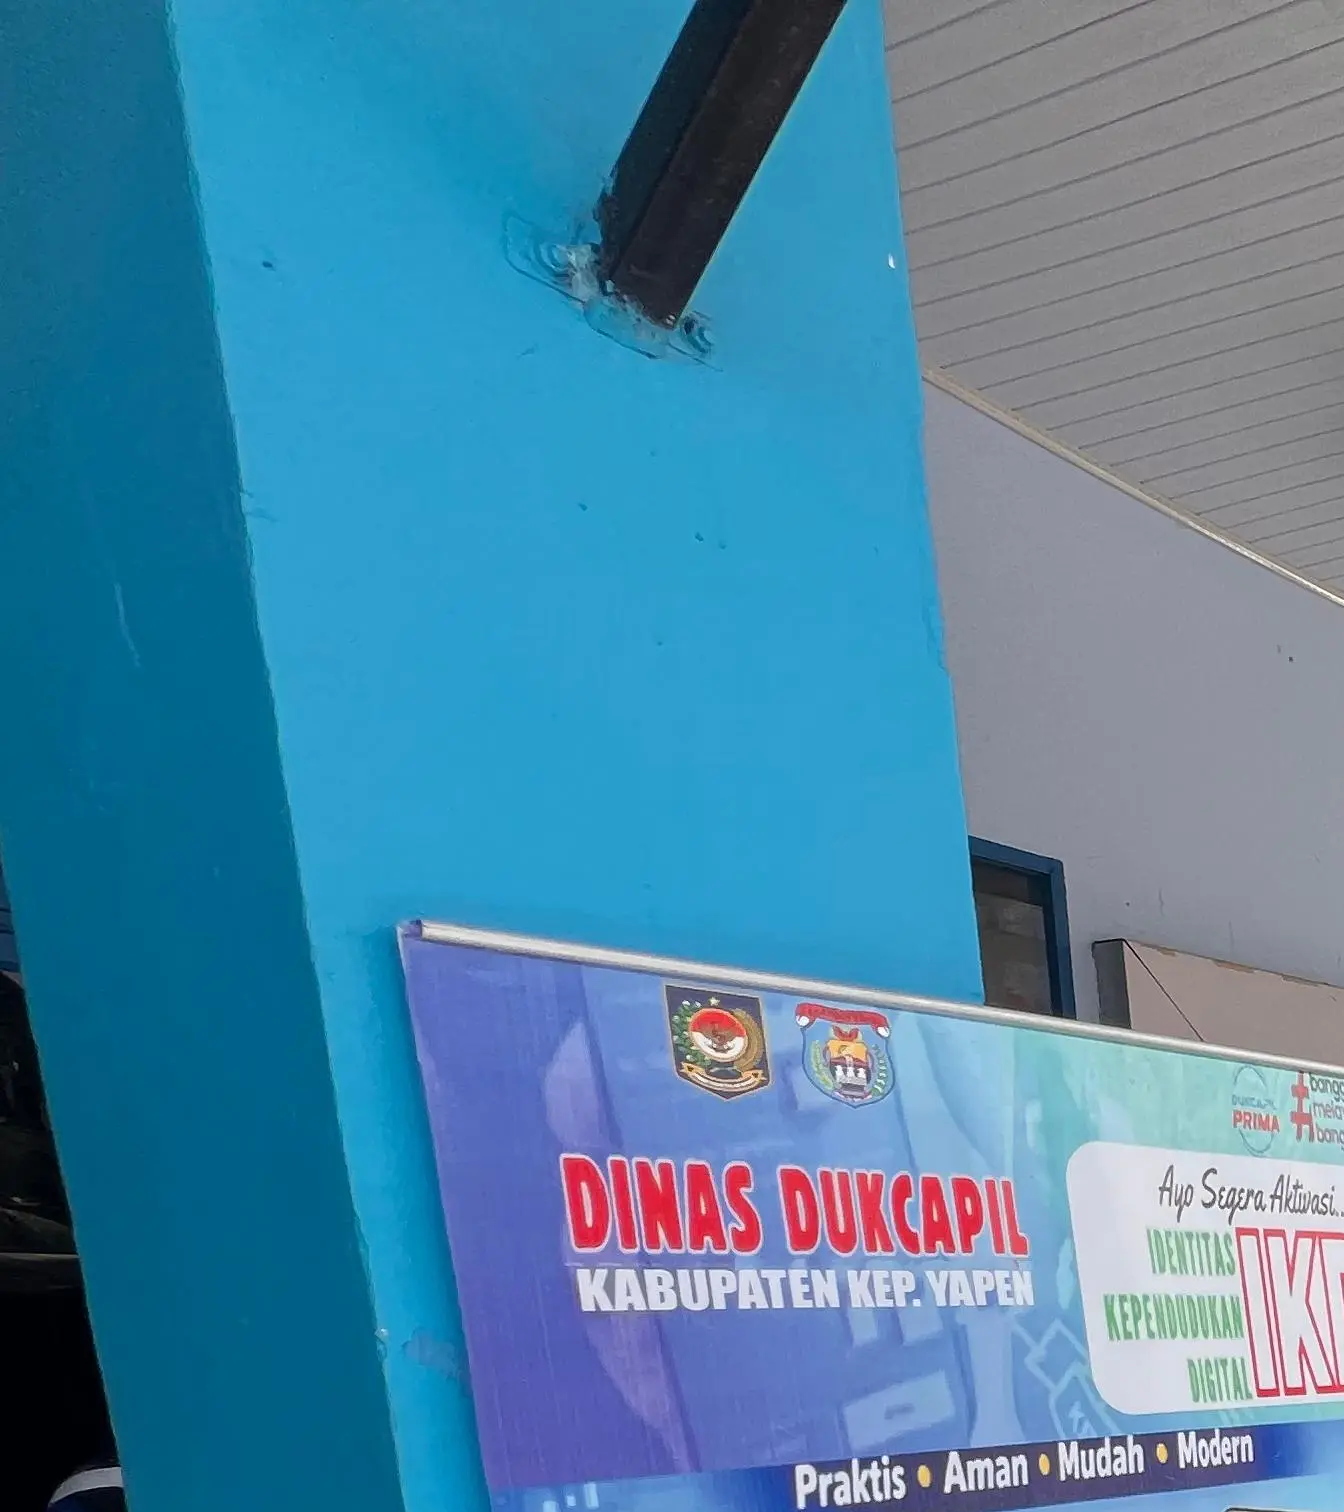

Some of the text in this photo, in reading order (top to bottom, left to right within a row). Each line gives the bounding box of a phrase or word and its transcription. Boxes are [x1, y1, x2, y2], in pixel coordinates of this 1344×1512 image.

[1232, 1110, 1281, 1133] PRIMA
[560, 1153, 1031, 1259] DINAS DUKCAPIL
[1158, 1164, 1194, 1223] Ayo
[1201, 1168, 1265, 1226] Segera
[1146, 1228, 1237, 1277] IDENTITAS
[576, 1267, 1035, 1312] KABUPATEN KEP. YAPEN
[1103, 1293, 1245, 1342] KEPENDUDUKAN
[1187, 1356, 1253, 1404] DIGITAL
[794, 1429, 1254, 1510] Praktis Aman Mudah Modern
